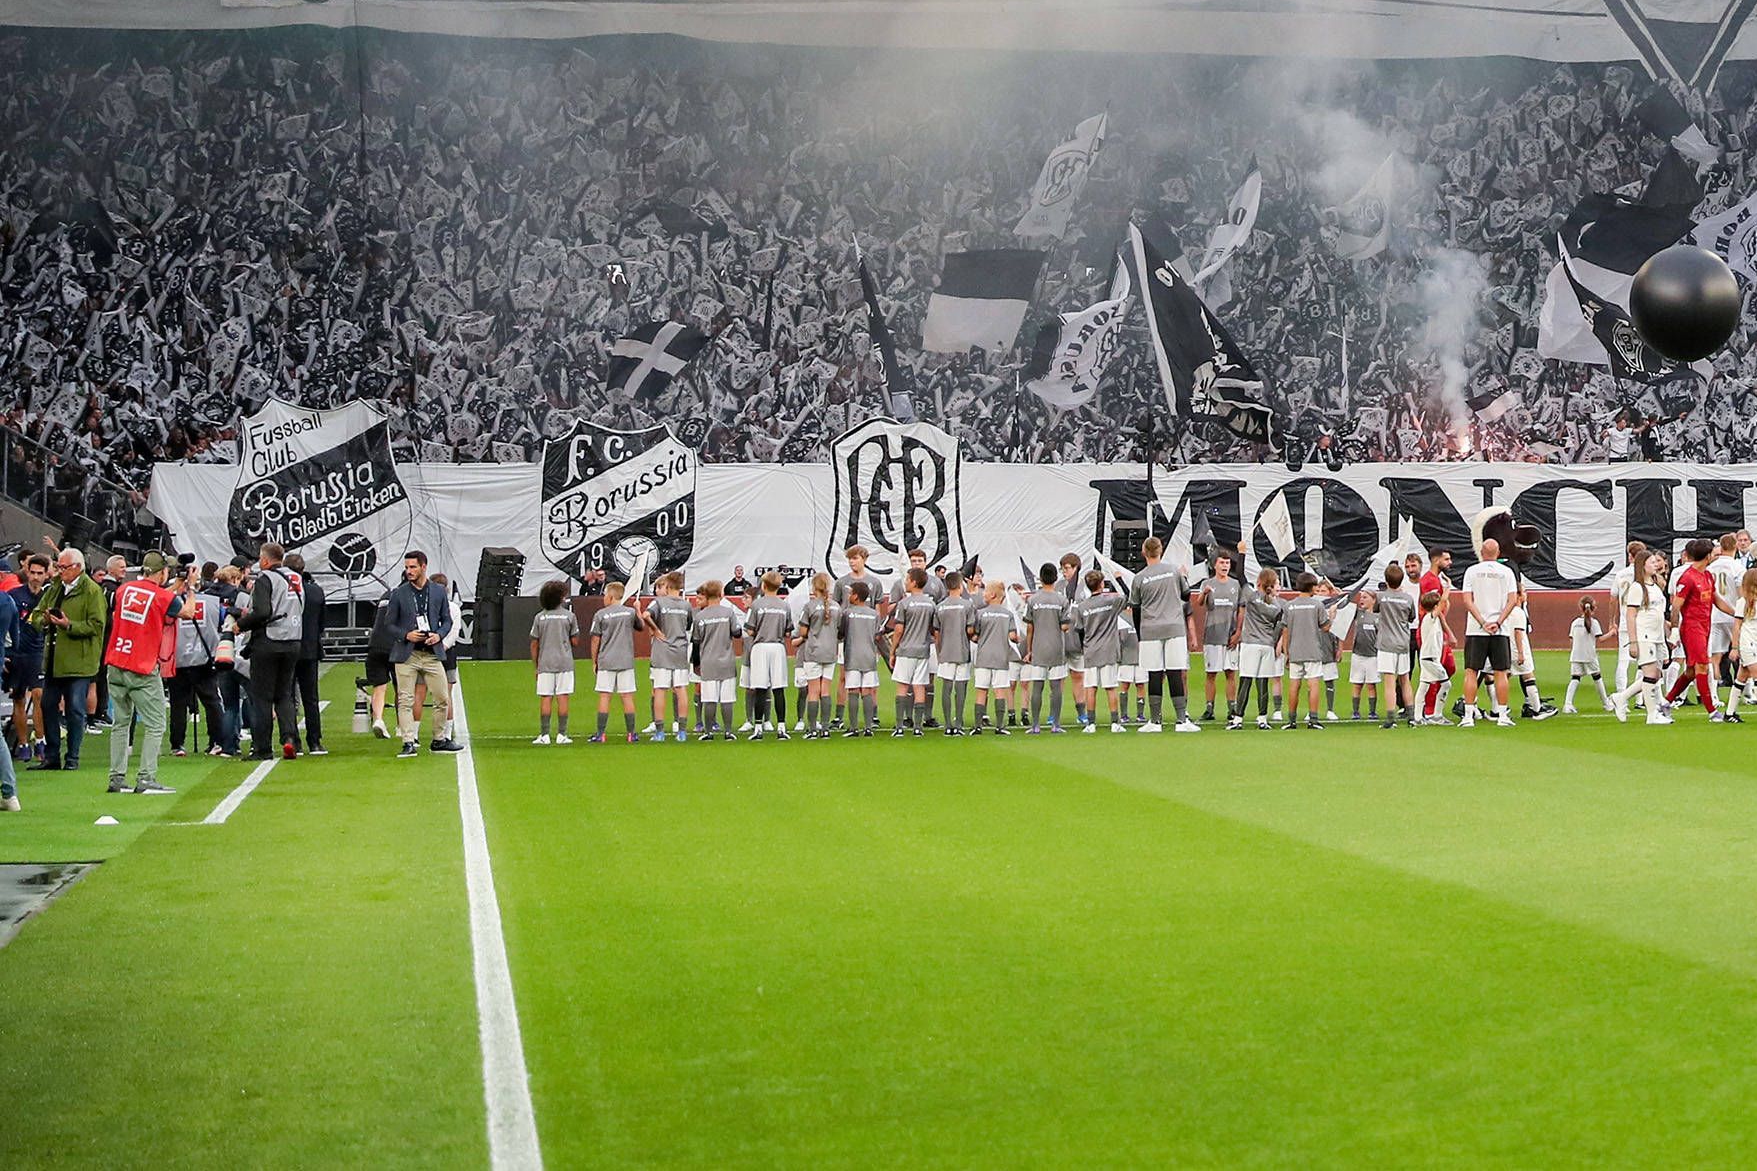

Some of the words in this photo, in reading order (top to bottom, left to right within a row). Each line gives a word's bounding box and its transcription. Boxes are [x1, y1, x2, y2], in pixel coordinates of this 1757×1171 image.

[250, 412, 322, 450] Fussball
[252, 442, 297, 477] Club
[562, 434, 595, 488] F.
[603, 434, 633, 464] C.
[242, 459, 375, 538] Borussia
[548, 449, 688, 552] Borussia
[115, 637, 133, 654] 22
